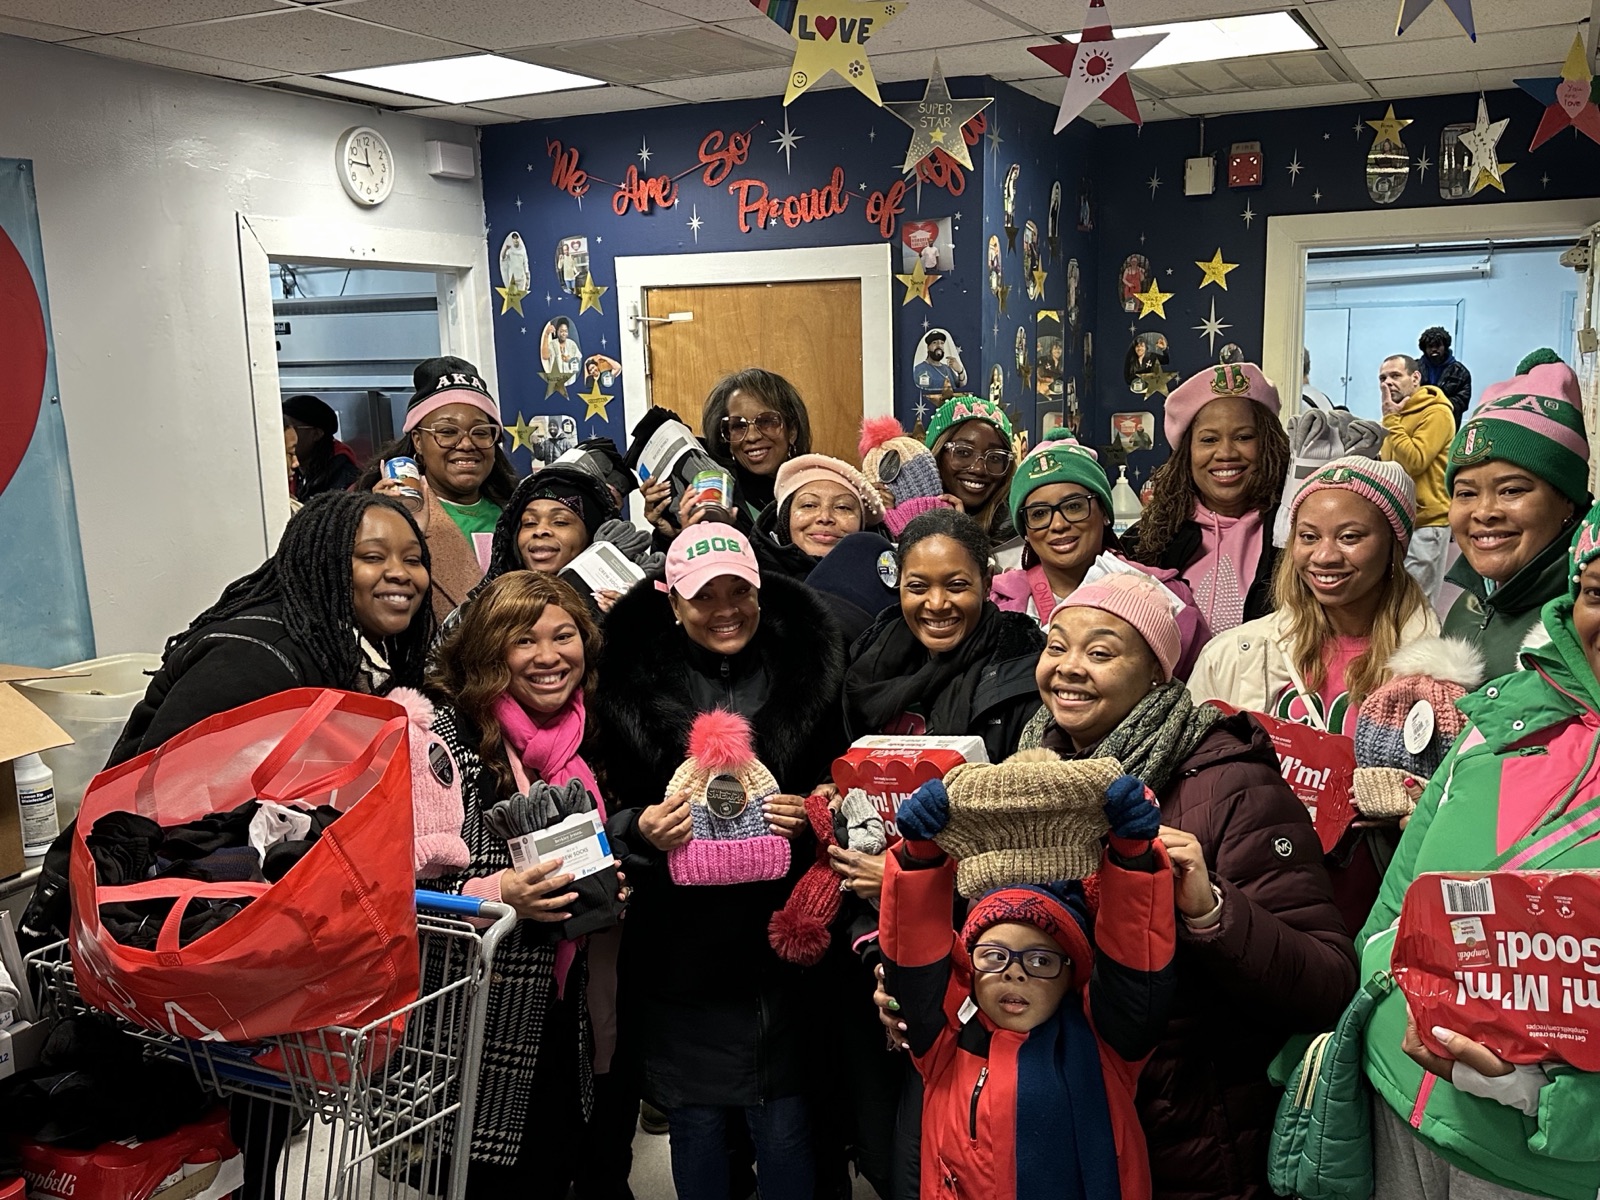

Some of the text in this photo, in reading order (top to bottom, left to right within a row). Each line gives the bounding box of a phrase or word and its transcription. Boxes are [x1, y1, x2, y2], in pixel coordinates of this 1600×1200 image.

[1564, 99, 1581, 107] love
[918, 102, 953, 115] SUPER
[919, 116, 952, 128] STAR
[363, 137, 370, 146] 12
[350, 146, 358, 156] 10
[378, 150, 383, 160] 2
[381, 163, 386, 173] 3
[546, 130, 751, 216] We Are So
[351, 172, 357, 181] 8
[366, 187, 371, 195] 6
[728, 165, 849, 233] Proud
[865, 180, 906, 239] of
[436, 373, 484, 391] AKA
[952, 402, 1005, 428] AKA
[686, 537, 741, 560] 1908
[573, 847, 589, 856] SOCKS
[1454, 971, 1550, 1012] M'm!
[1526, 1023, 1589, 1034] campbells.com/recipes
[1529, 1031, 1549, 1039] create
[1557, 1032, 1574, 1041] ready
[1574, 1034, 1586, 1043] Get
